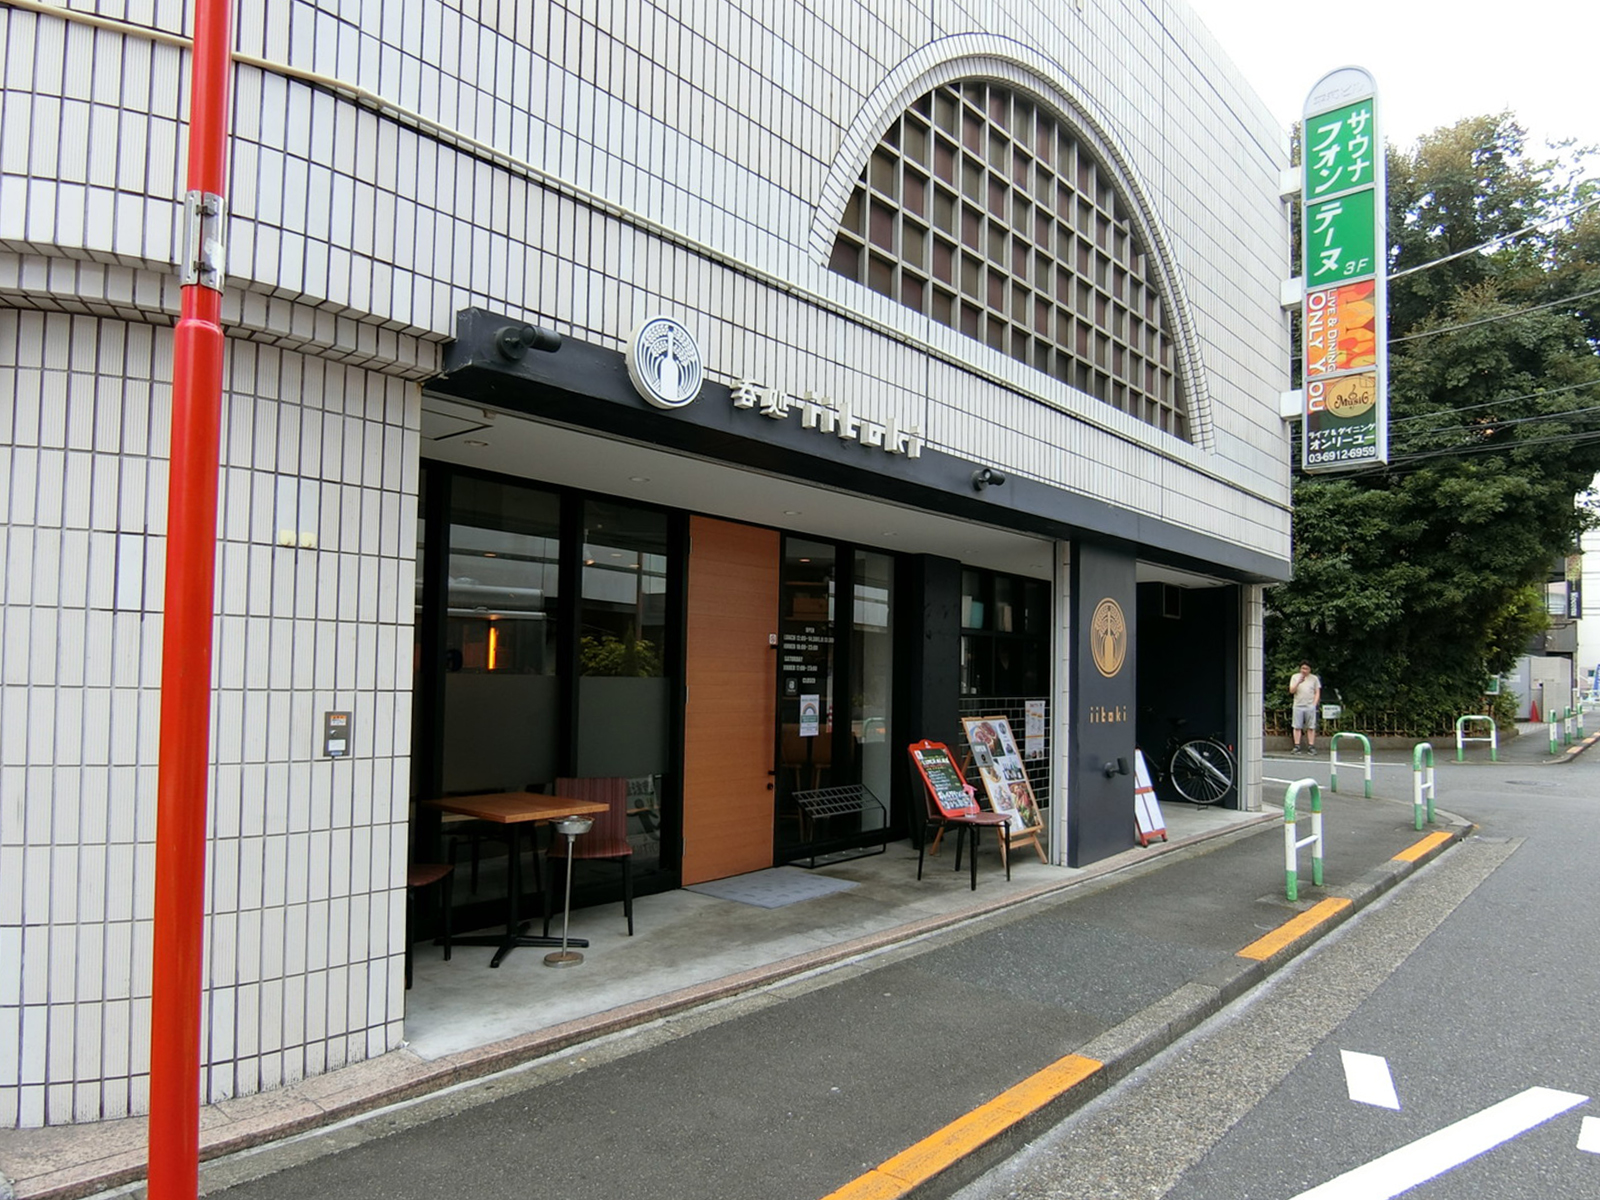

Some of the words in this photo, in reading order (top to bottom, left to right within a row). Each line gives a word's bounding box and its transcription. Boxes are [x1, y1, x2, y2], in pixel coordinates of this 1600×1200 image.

[1347, 109, 1371, 183] サウナ
[1343, 257, 1369, 275] 3F
[1326, 288, 1338, 316] LIVE
[1308, 293, 1327, 349] ONLY
[1327, 318, 1338, 328] &
[1326, 329, 1338, 373] DINING
[1309, 434, 1375, 451] オンリーユー
[1308, 446, 1375, 463] 03-6912-6959
